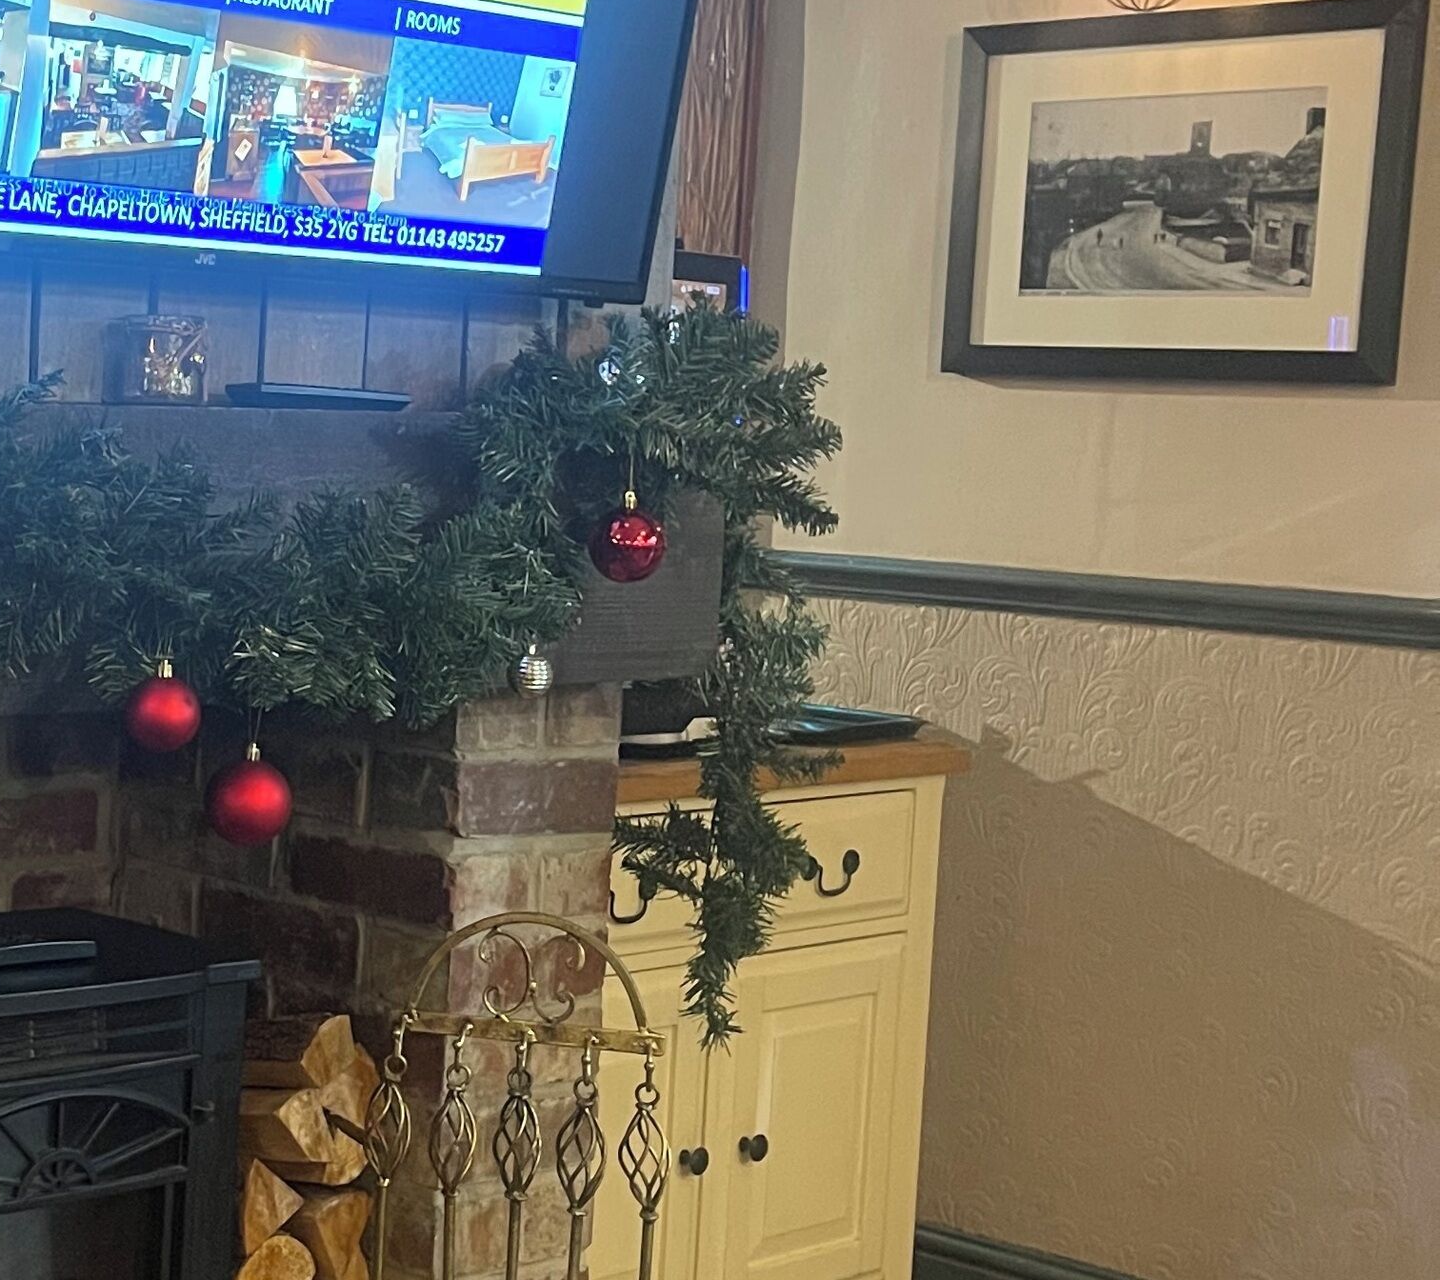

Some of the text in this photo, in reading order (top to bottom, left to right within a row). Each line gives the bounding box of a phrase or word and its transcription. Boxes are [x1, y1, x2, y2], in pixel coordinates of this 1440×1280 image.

[405, 9, 461, 35] ROOMS
[9, 188, 62, 218] LANE,
[68, 194, 195, 231] CHAPELTOWN,
[199, 206, 289, 239] SHEFFIELD,
[293, 218, 323, 239] S35
[327, 219, 358, 241] 2YG
[362, 222, 394, 245] TEL:
[396, 227, 446, 249] 01143
[447, 230, 506, 253] 495257
[84, 184, 97, 198] to
[353, 210, 365, 224] to
[194, 253, 216, 265] JVC
